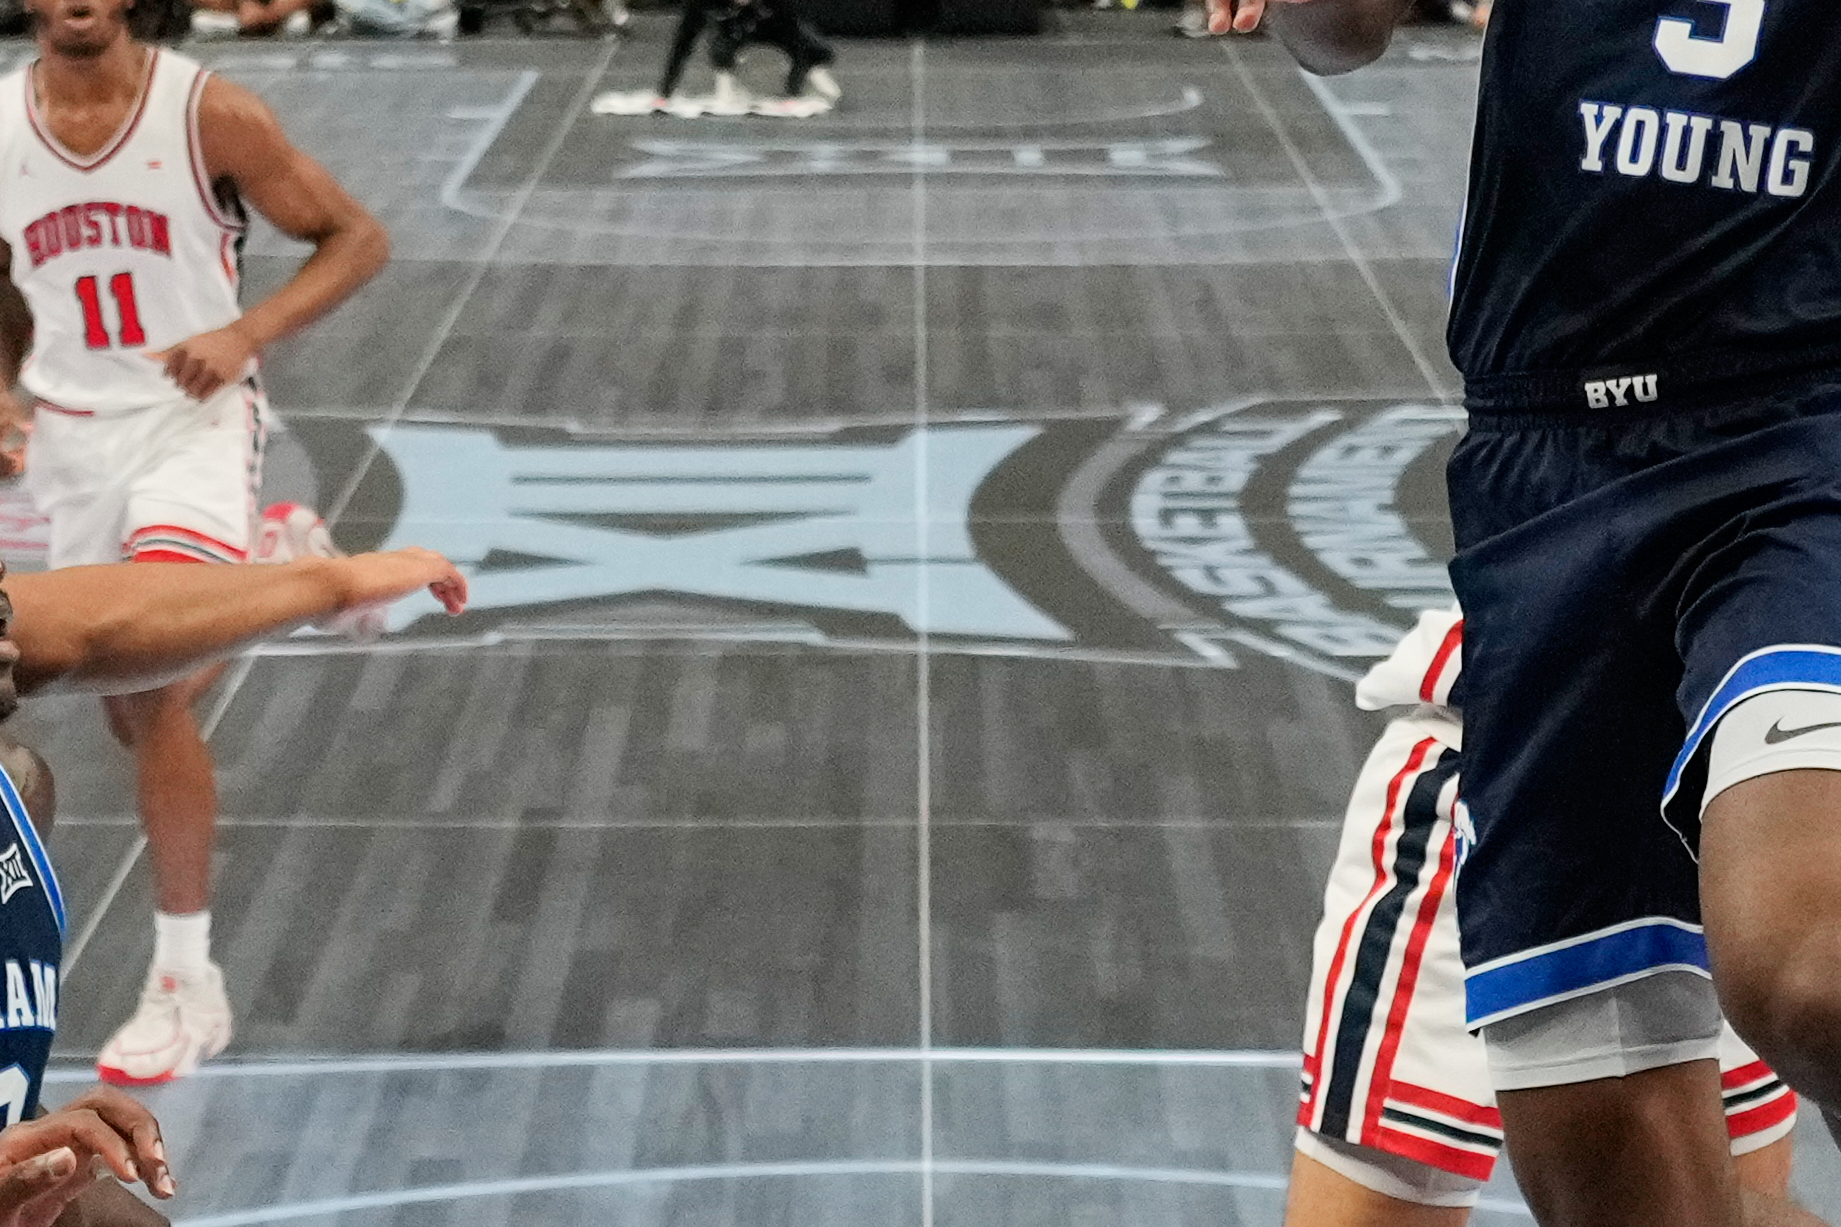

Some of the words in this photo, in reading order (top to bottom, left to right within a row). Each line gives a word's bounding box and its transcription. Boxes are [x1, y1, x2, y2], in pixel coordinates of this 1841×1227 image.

[1577, 100, 1815, 199] YOUNG
[23, 202, 172, 268] HOUSTON
[75, 272, 146, 350] 11
[1584, 373, 1659, 410] BYU
[1130, 408, 1409, 657] BASKETBALL
[1287, 404, 1470, 610] URNAMENT
[0, 958, 57, 1032] AM
